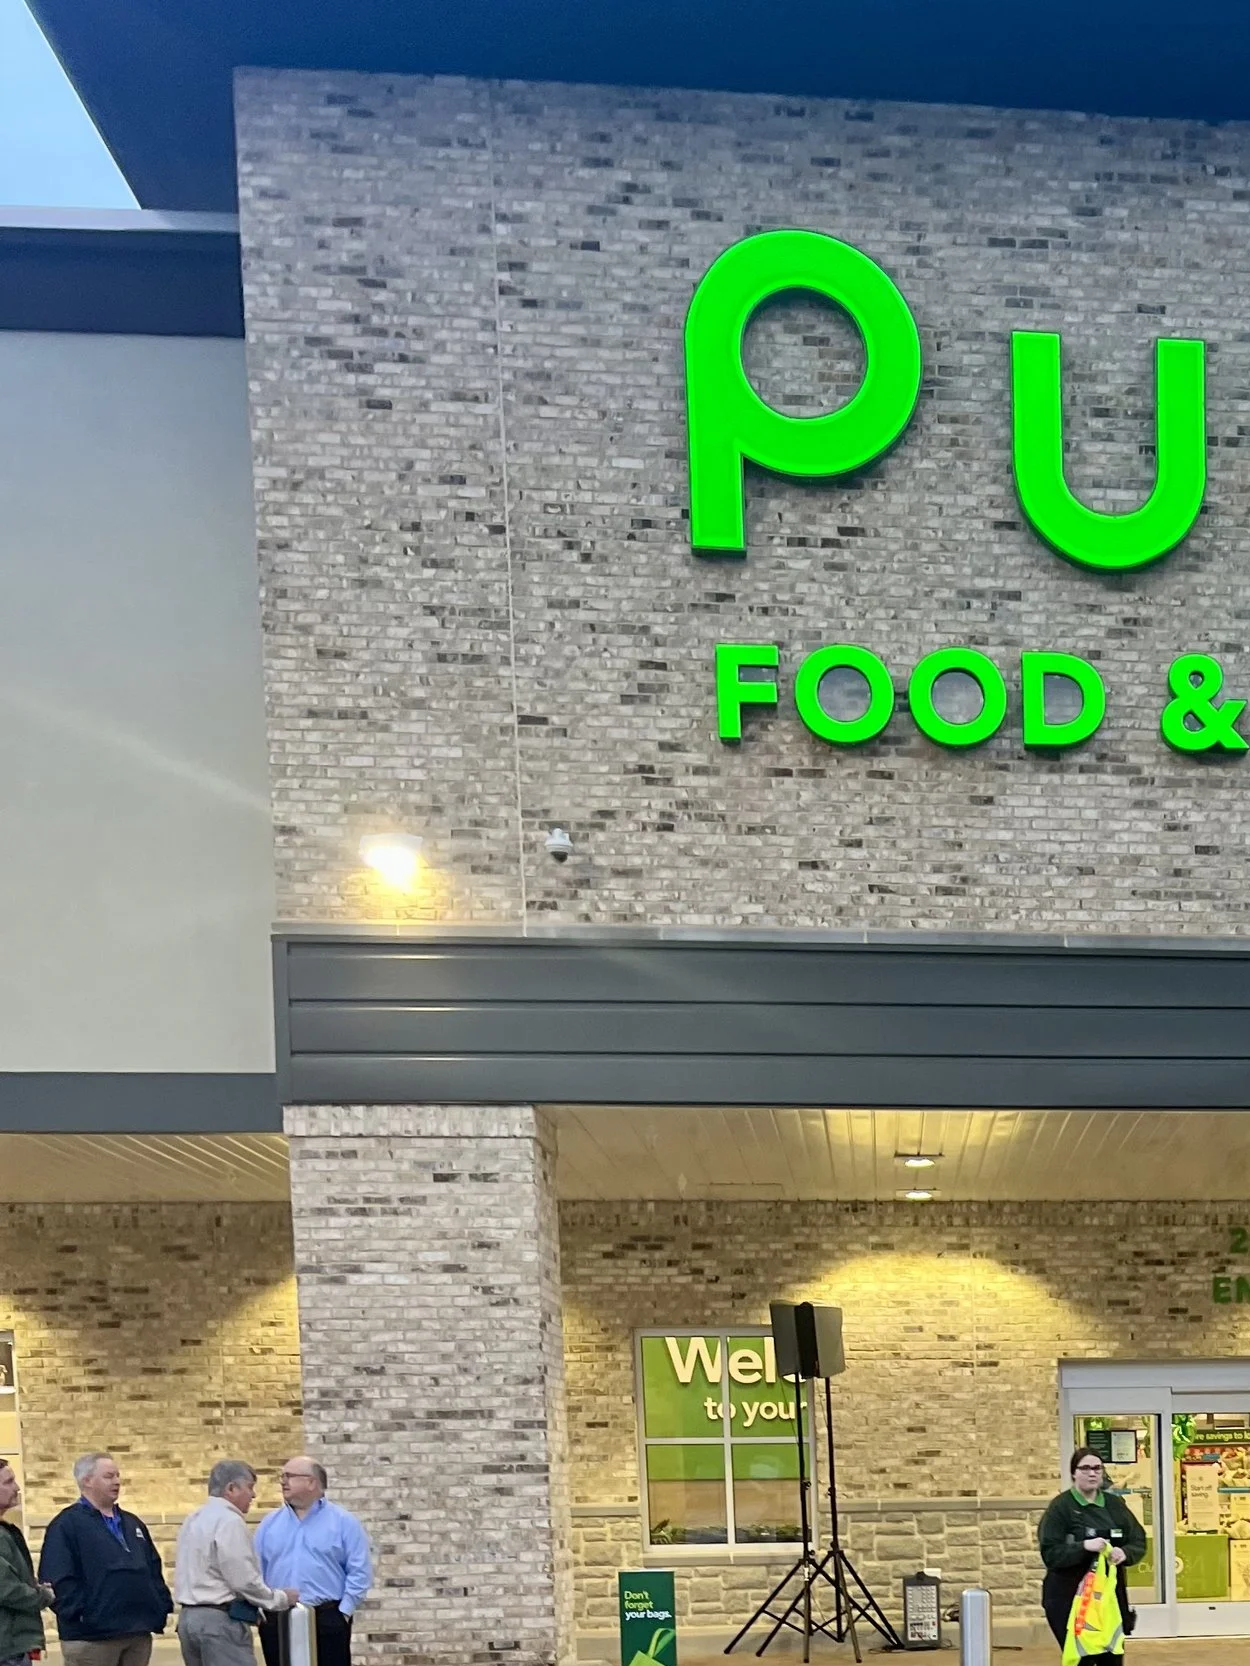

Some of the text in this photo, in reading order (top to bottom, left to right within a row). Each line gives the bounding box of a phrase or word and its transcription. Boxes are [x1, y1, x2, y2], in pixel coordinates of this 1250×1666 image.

[715, 643, 1106, 750] FOOD
[1160, 652, 1250, 755] &
[665, 1336, 807, 1384] Wel
[704, 1397, 736, 1421] to
[624, 1590, 650, 1600] Don't
[624, 1600, 654, 1612] forget
[625, 1611, 646, 1621] your
